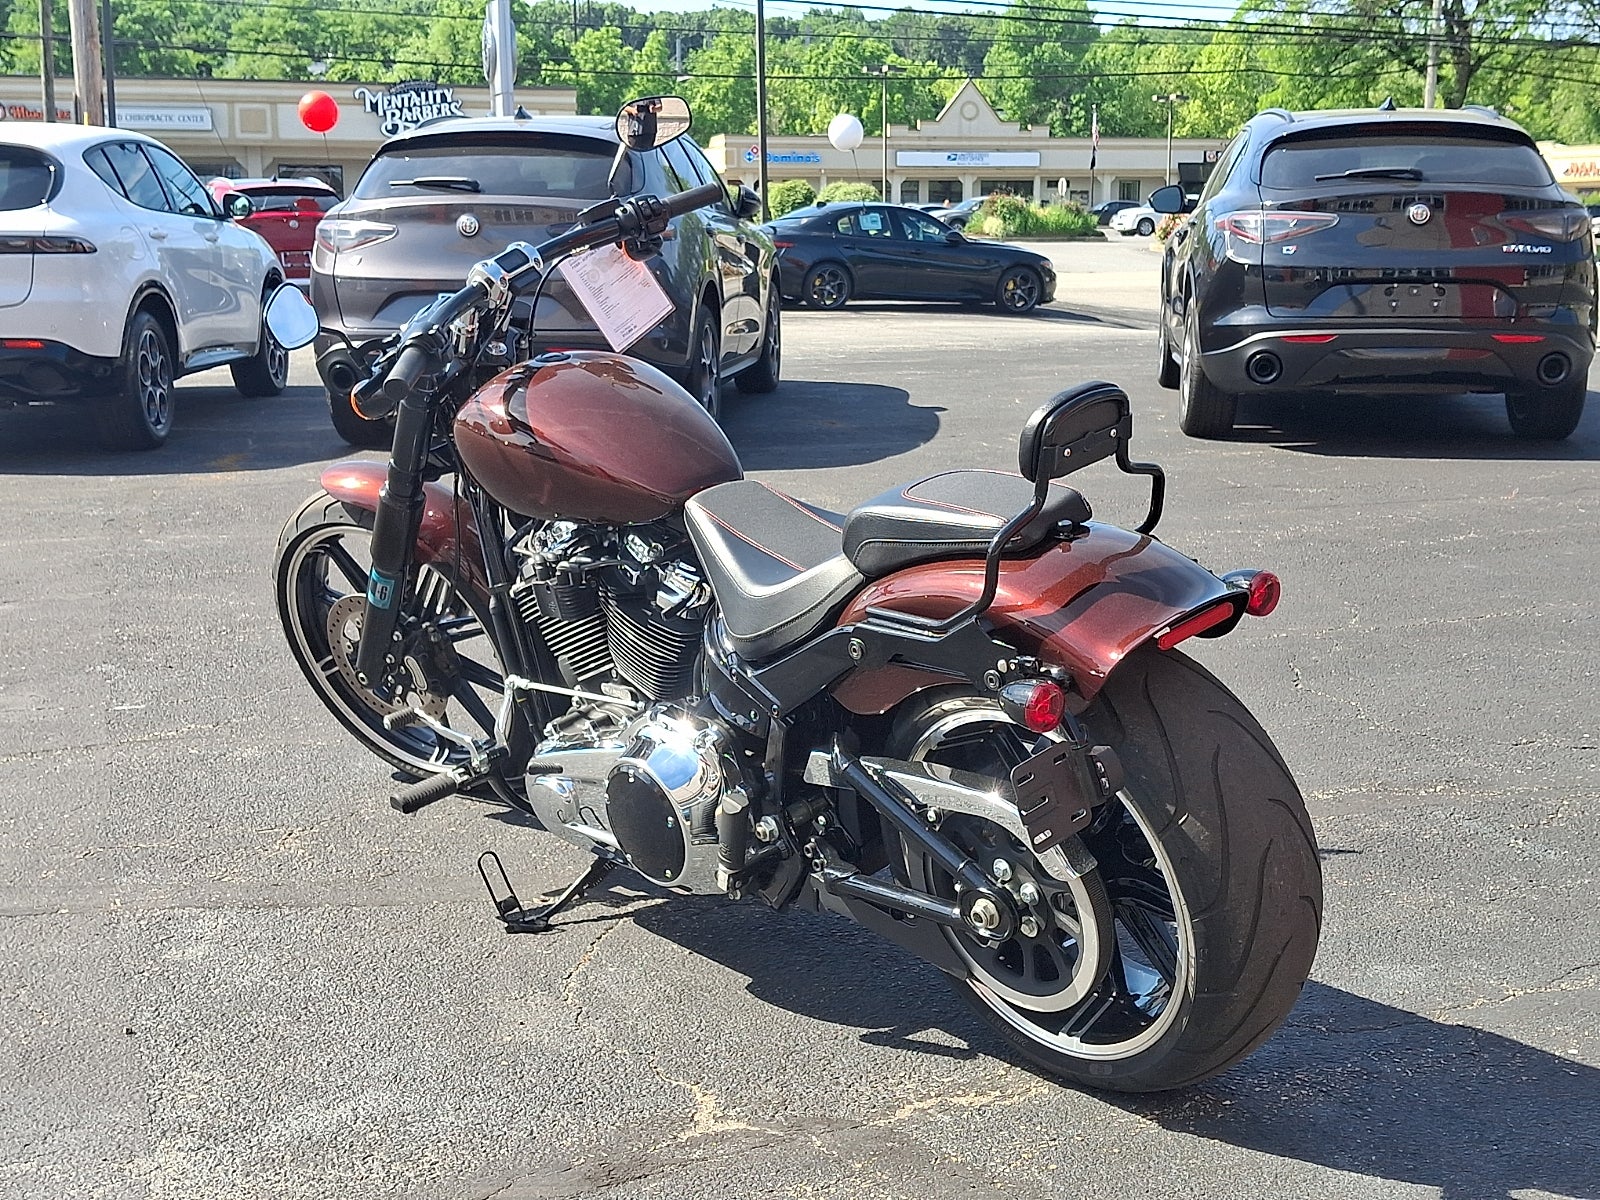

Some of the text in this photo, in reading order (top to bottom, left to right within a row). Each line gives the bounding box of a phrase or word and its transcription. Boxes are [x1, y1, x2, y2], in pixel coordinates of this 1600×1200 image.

[354, 87, 453, 117] MENTALITY
[125, 113, 174, 123] CHIROPRACTIC
[178, 114, 205, 123] CENTER
[381, 99, 465, 137] BARBERS
[765, 151, 820, 163] Domino's
